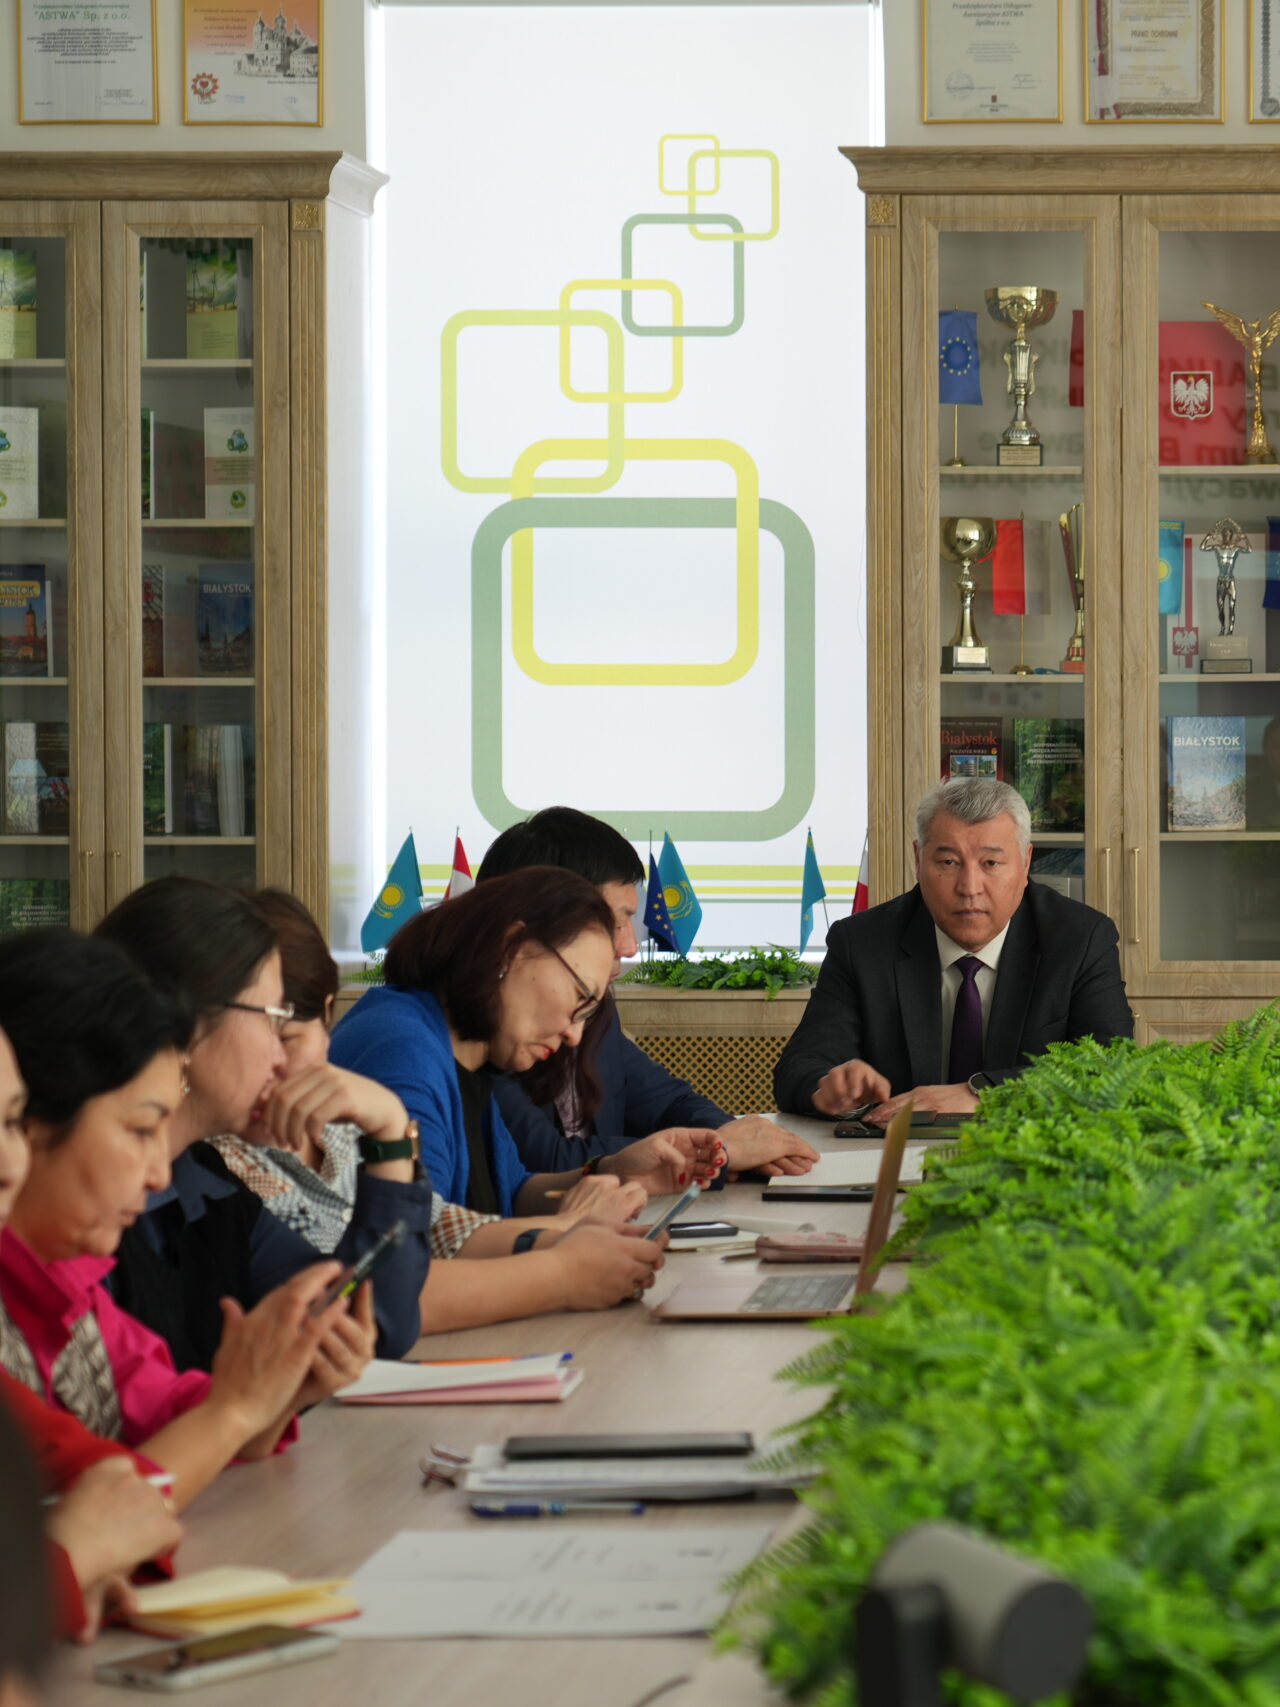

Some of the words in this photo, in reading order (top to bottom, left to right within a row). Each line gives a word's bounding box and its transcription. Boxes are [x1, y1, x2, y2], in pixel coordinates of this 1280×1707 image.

[34, 11, 80, 21] "ASTWA"
[202, 583, 252, 593] BIAŁYSTOK
[941, 729, 999, 749] Białystok
[1173, 736, 1241, 747] BIAŁYSTOK
